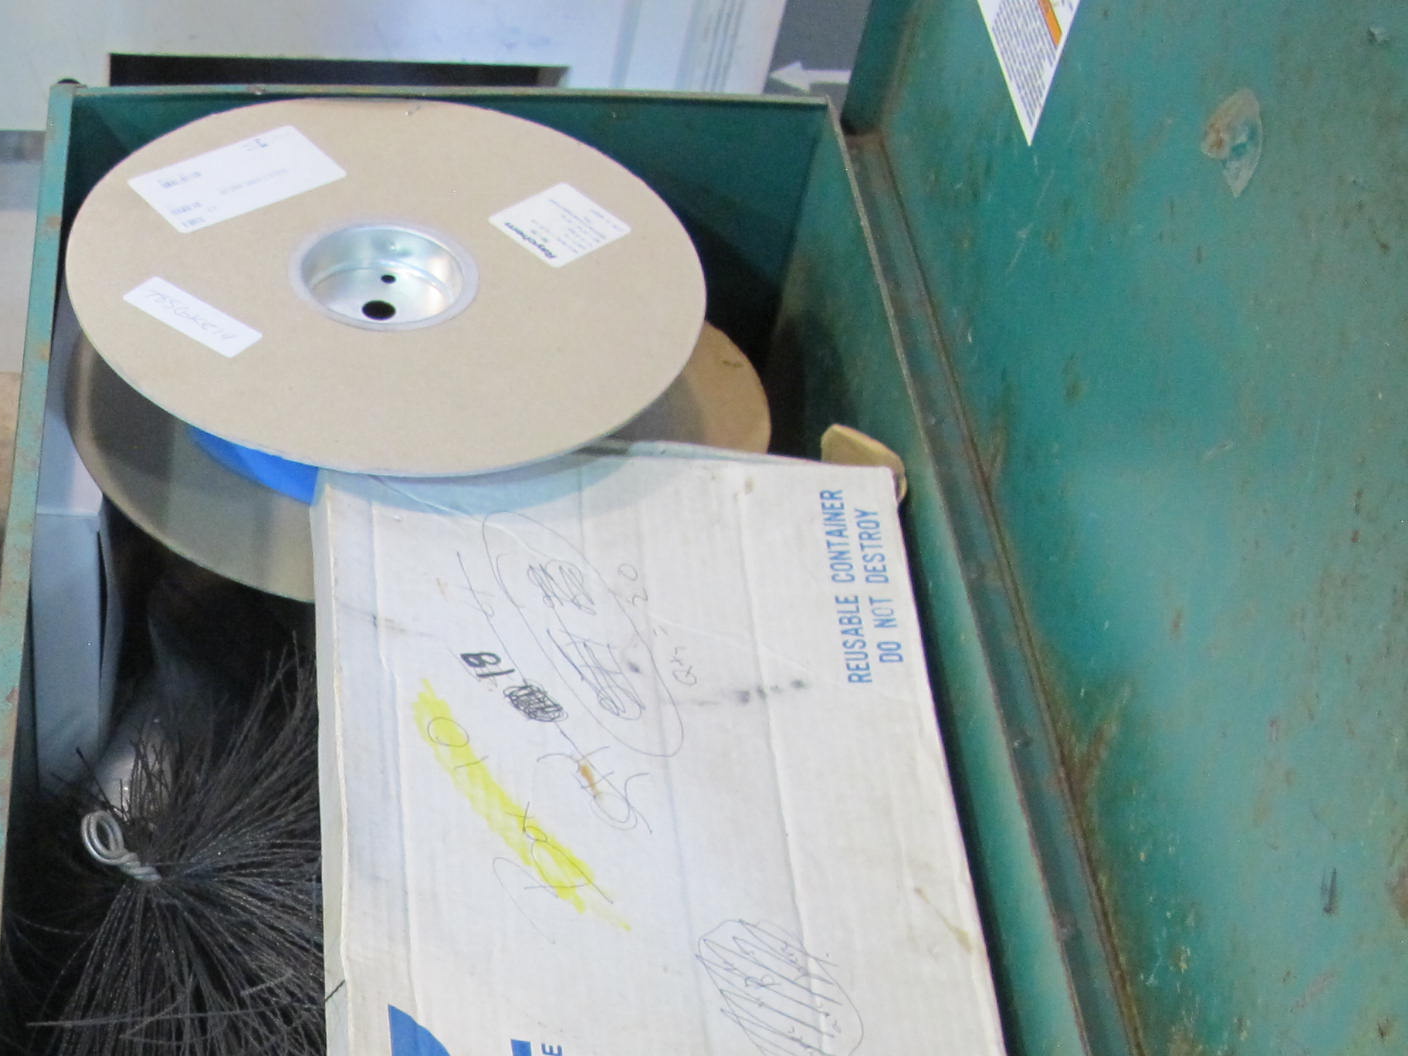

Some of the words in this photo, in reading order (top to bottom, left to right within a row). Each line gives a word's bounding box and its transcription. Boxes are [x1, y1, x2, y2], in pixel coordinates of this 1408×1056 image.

[819, 489, 856, 584] CONTAINER
[854, 508, 889, 584] DESTROY
[835, 595, 873, 684] REUSABLE
[868, 596, 899, 629] NOT
[876, 640, 904, 663] DO
